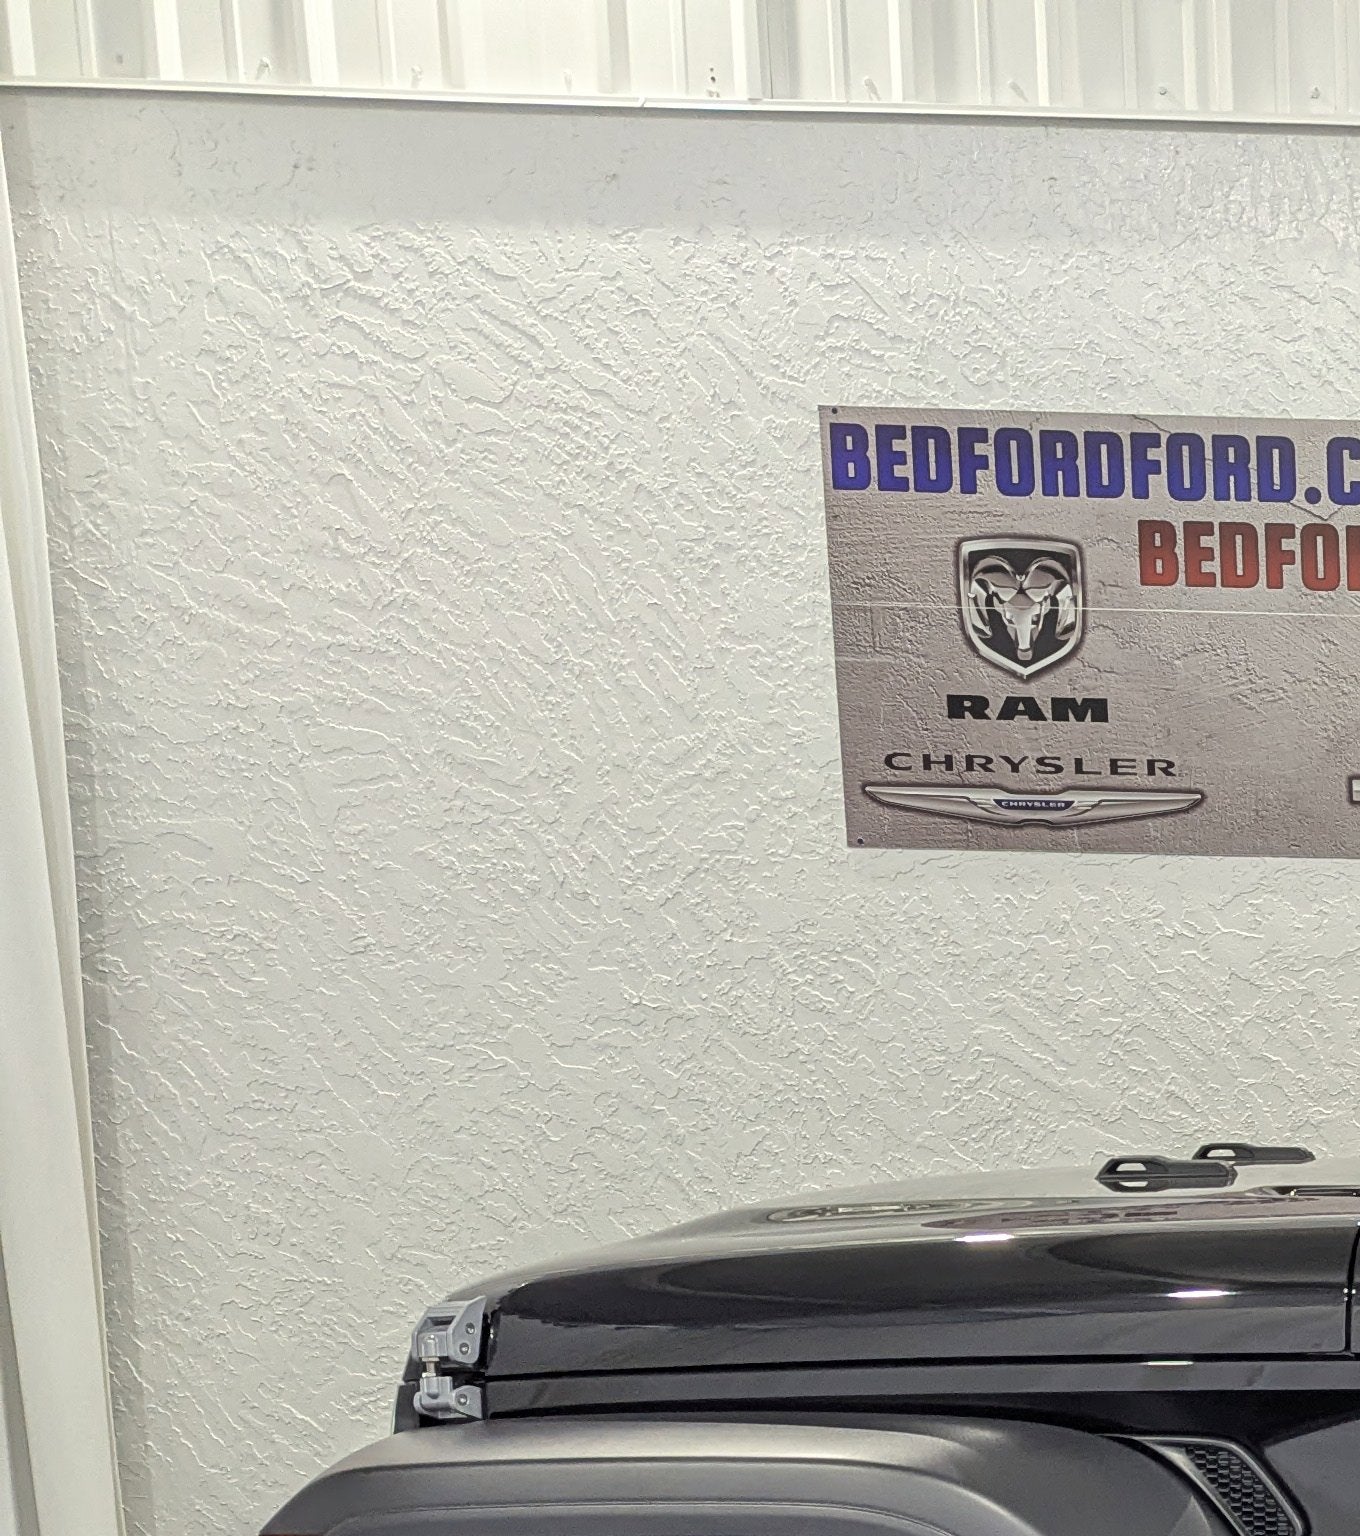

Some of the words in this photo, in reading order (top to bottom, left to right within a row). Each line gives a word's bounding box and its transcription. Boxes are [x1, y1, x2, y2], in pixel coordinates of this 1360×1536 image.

[945, 694, 1109, 724] RAM
[883, 751, 1178, 778] CHRYSLER
[1001, 800, 1066, 808] CHRYSLER
